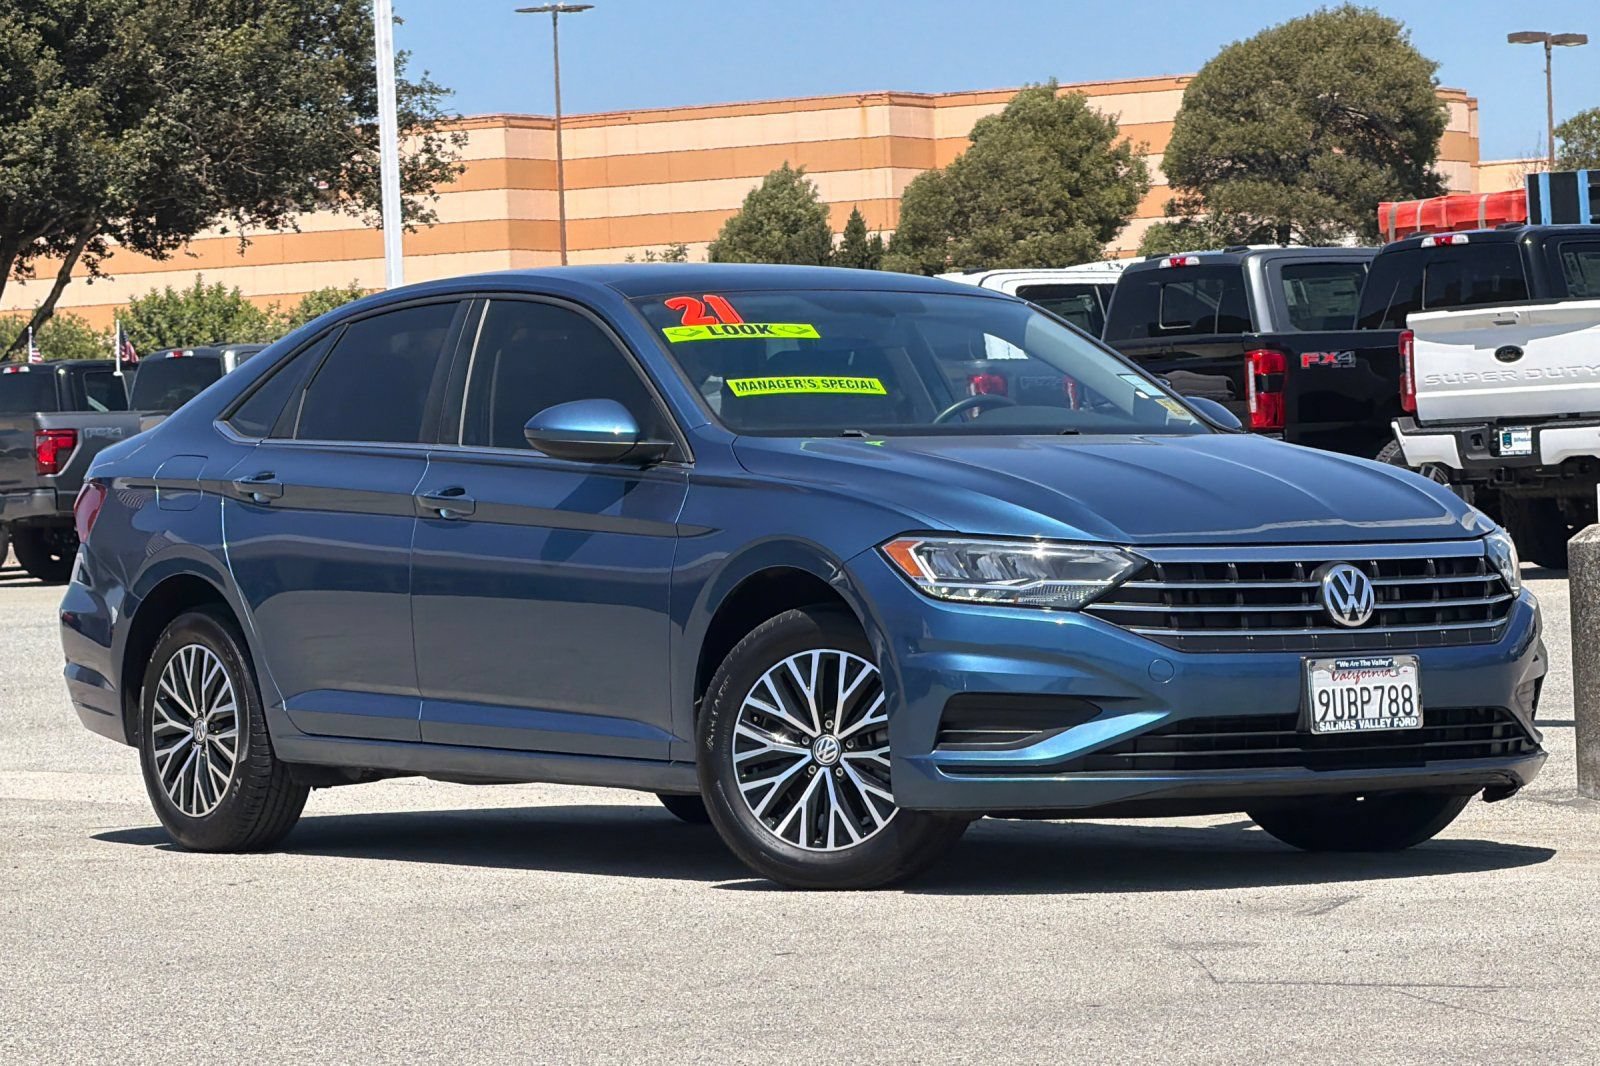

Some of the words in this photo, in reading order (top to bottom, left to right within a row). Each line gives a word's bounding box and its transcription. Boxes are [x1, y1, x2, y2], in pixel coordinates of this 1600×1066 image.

[664, 295, 744, 326] 21
[706, 324, 776, 336] LOOK
[1301, 351, 1355, 368] FX4
[1425, 370, 1518, 385] SUPER
[1525, 365, 1600, 379] DUTY
[735, 379, 817, 392] MANAGER'S
[819, 379, 876, 390] SPECIAL
[1332, 669, 1398, 684] California
[1318, 684, 1414, 721] 9UBP788
[1359, 718, 1391, 729] VALLEY
[1394, 717, 1417, 727] FORD
